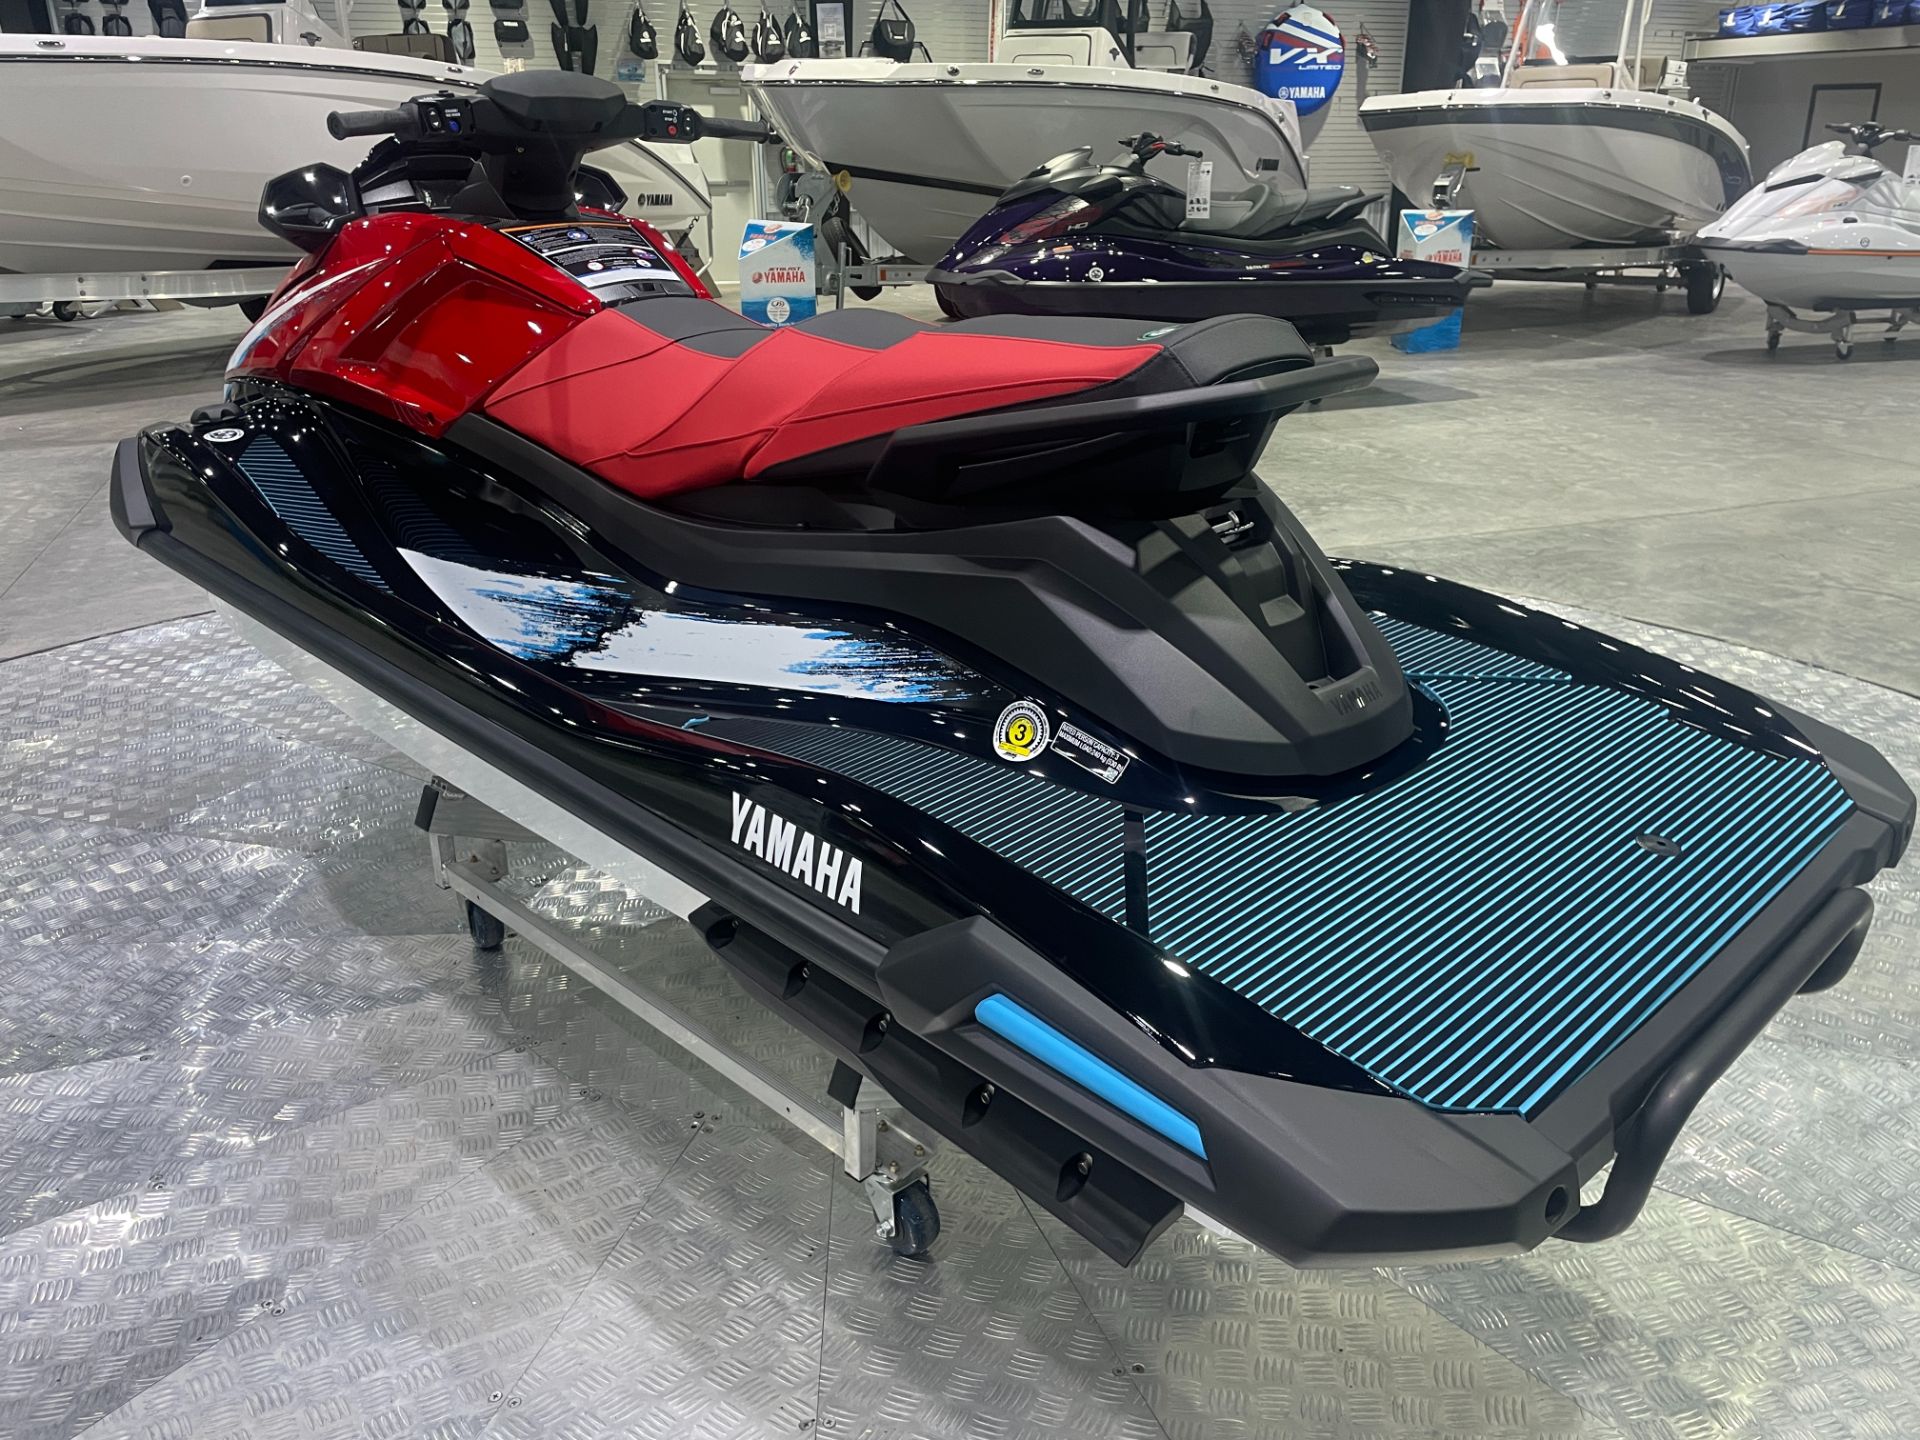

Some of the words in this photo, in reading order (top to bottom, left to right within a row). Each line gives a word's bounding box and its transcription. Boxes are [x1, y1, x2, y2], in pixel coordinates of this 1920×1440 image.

[1289, 86, 1326, 99] YAMAHA
[646, 194, 673, 206] YAMAHA
[763, 271, 806, 283] YAMAHA
[1329, 681, 1384, 715] YAMAHA
[1014, 724, 1027, 741] 3
[1058, 730, 1081, 747] MAXIMUM
[1076, 731, 1094, 746] PERSON
[731, 791, 862, 915] YAMAHA
